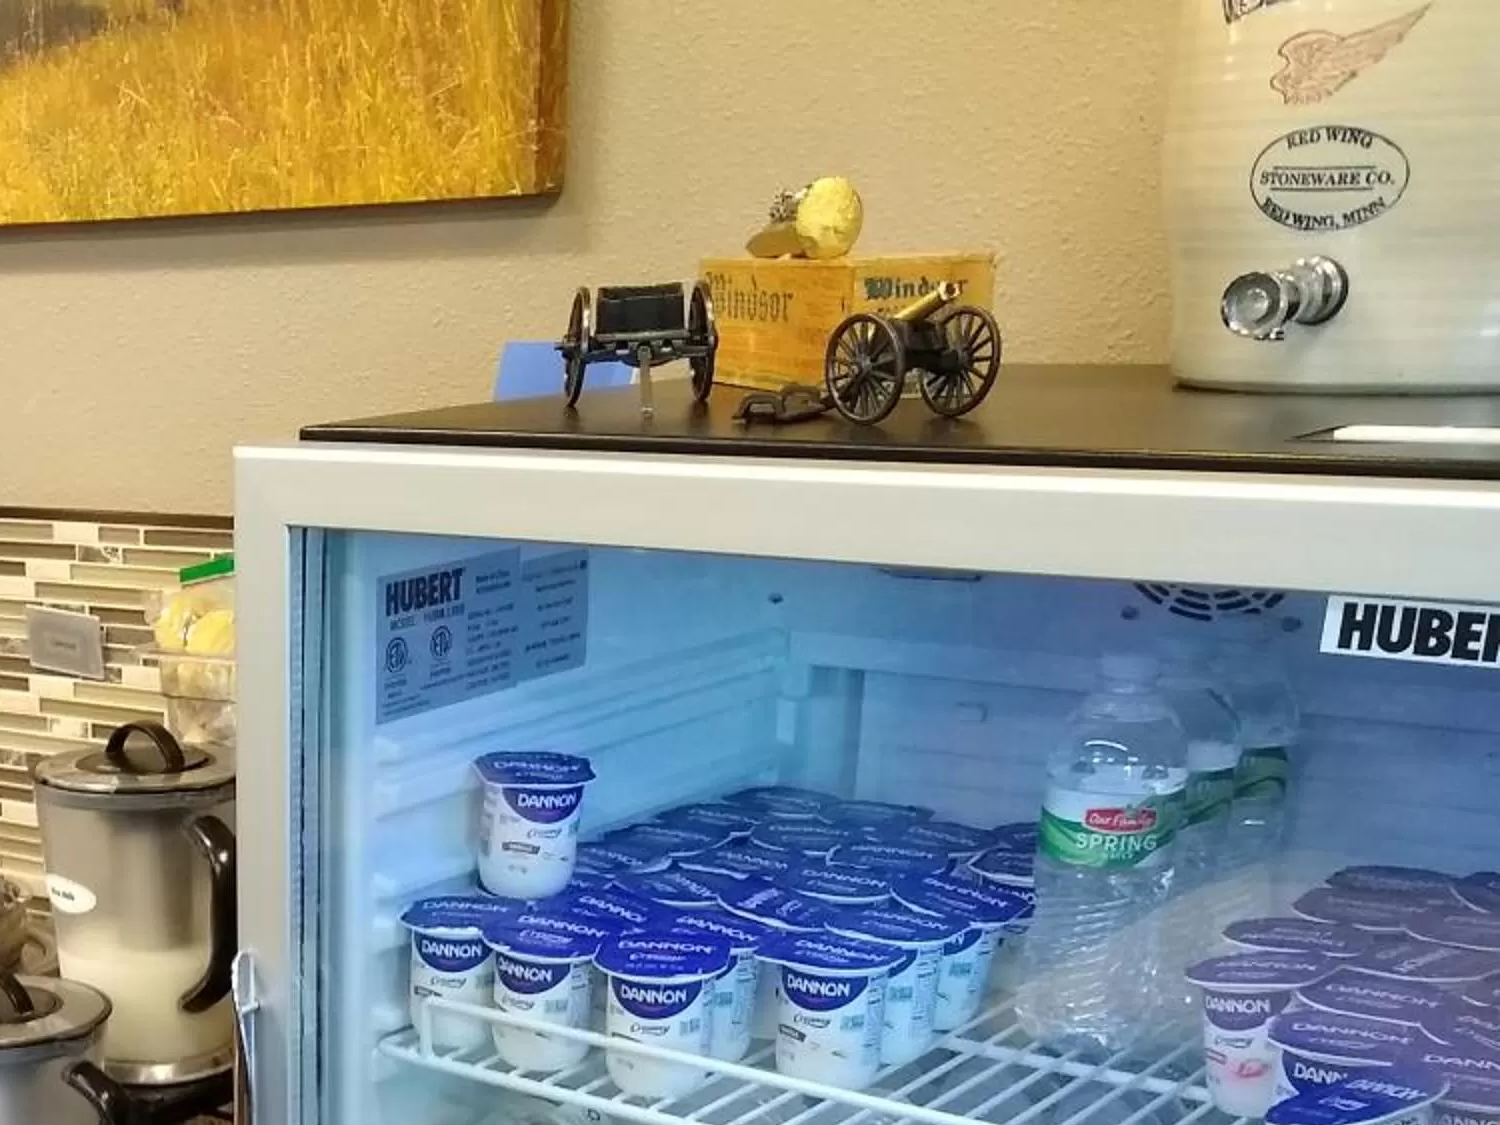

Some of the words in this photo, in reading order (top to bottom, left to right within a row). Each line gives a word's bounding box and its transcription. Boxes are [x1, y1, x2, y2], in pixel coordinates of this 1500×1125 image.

[1287, 130, 1322, 149] RED
[1325, 126, 1373, 149] WING
[1259, 170, 1361, 186] STONEWARE
[1365, 170, 1395, 186] CO.
[1262, 196, 1291, 222] RED
[863, 275, 969, 301] Windr
[385, 567, 464, 617] HUBERT
[517, 792, 577, 808] DANNON
[1075, 832, 1158, 852] SPRING
[518, 915, 606, 938] DANNON
[421, 939, 483, 958] DANNON
[617, 941, 712, 955] DANNON
[621, 984, 688, 1005] DANNON
[787, 973, 851, 998] DANNON
[1205, 995, 1271, 1014] DANNON
[1423, 1053, 1500, 1072] DANN
[1292, 1062, 1349, 1085] DANN
